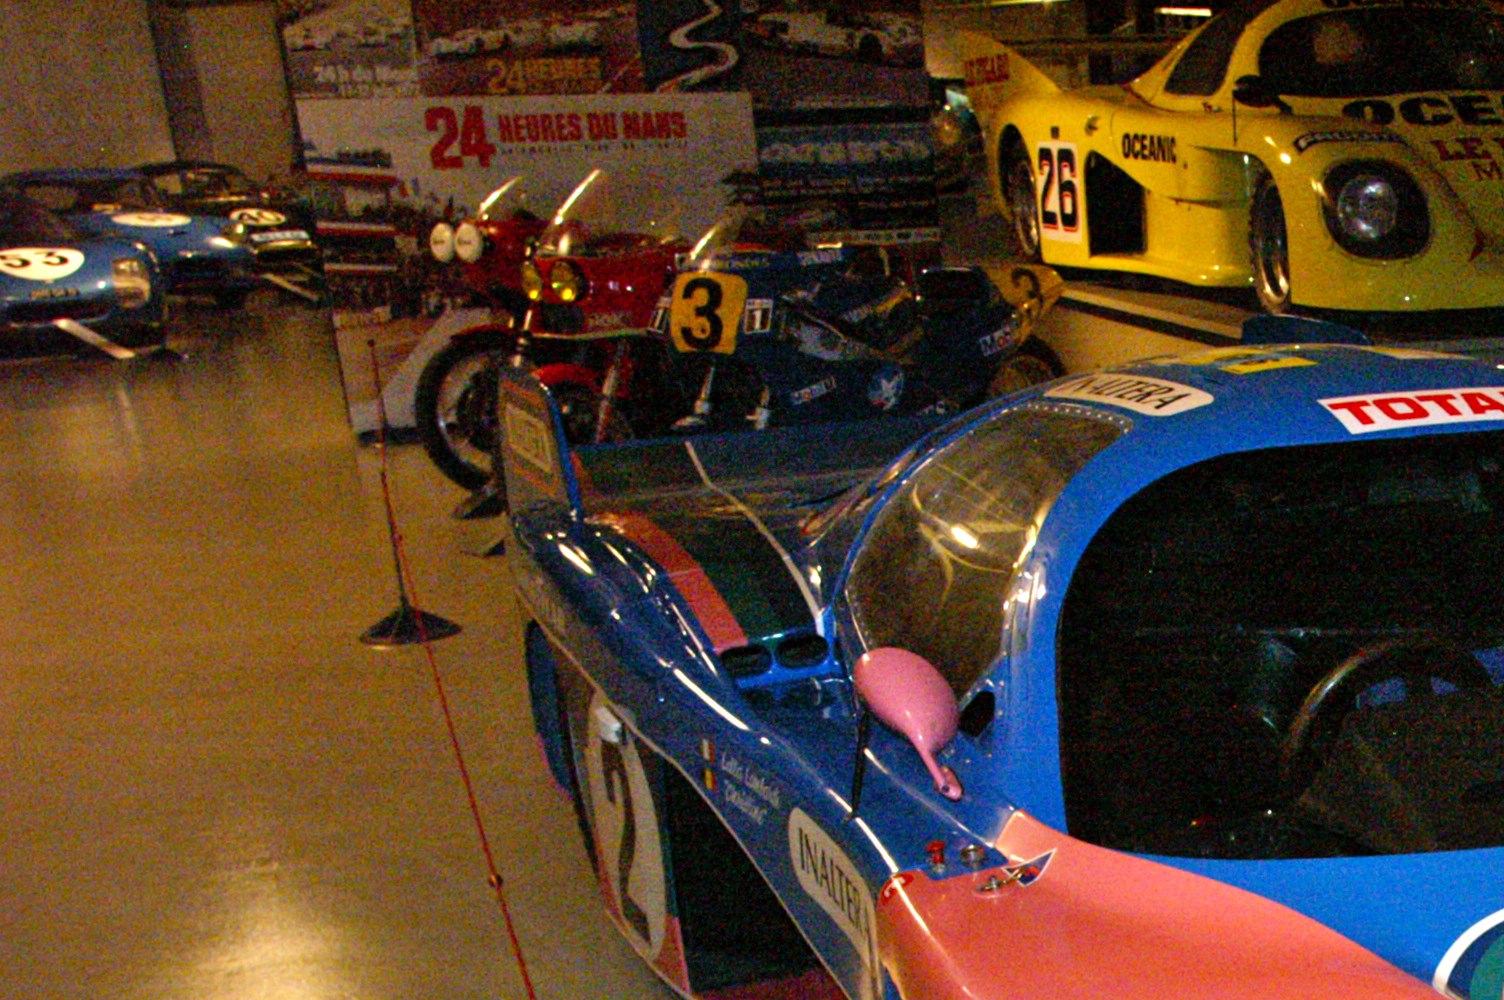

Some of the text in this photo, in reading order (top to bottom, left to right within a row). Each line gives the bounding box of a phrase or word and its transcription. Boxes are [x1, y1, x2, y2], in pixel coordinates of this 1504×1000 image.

[424, 105, 496, 170] 24
[500, 113, 583, 143] HEURES
[587, 112, 618, 140] DU
[621, 110, 688, 140] MANS
[1122, 133, 1177, 164] OCEANIC
[1431, 138, 1492, 161] LE
[1038, 147, 1079, 233] 26
[680, 277, 724, 350] 3
